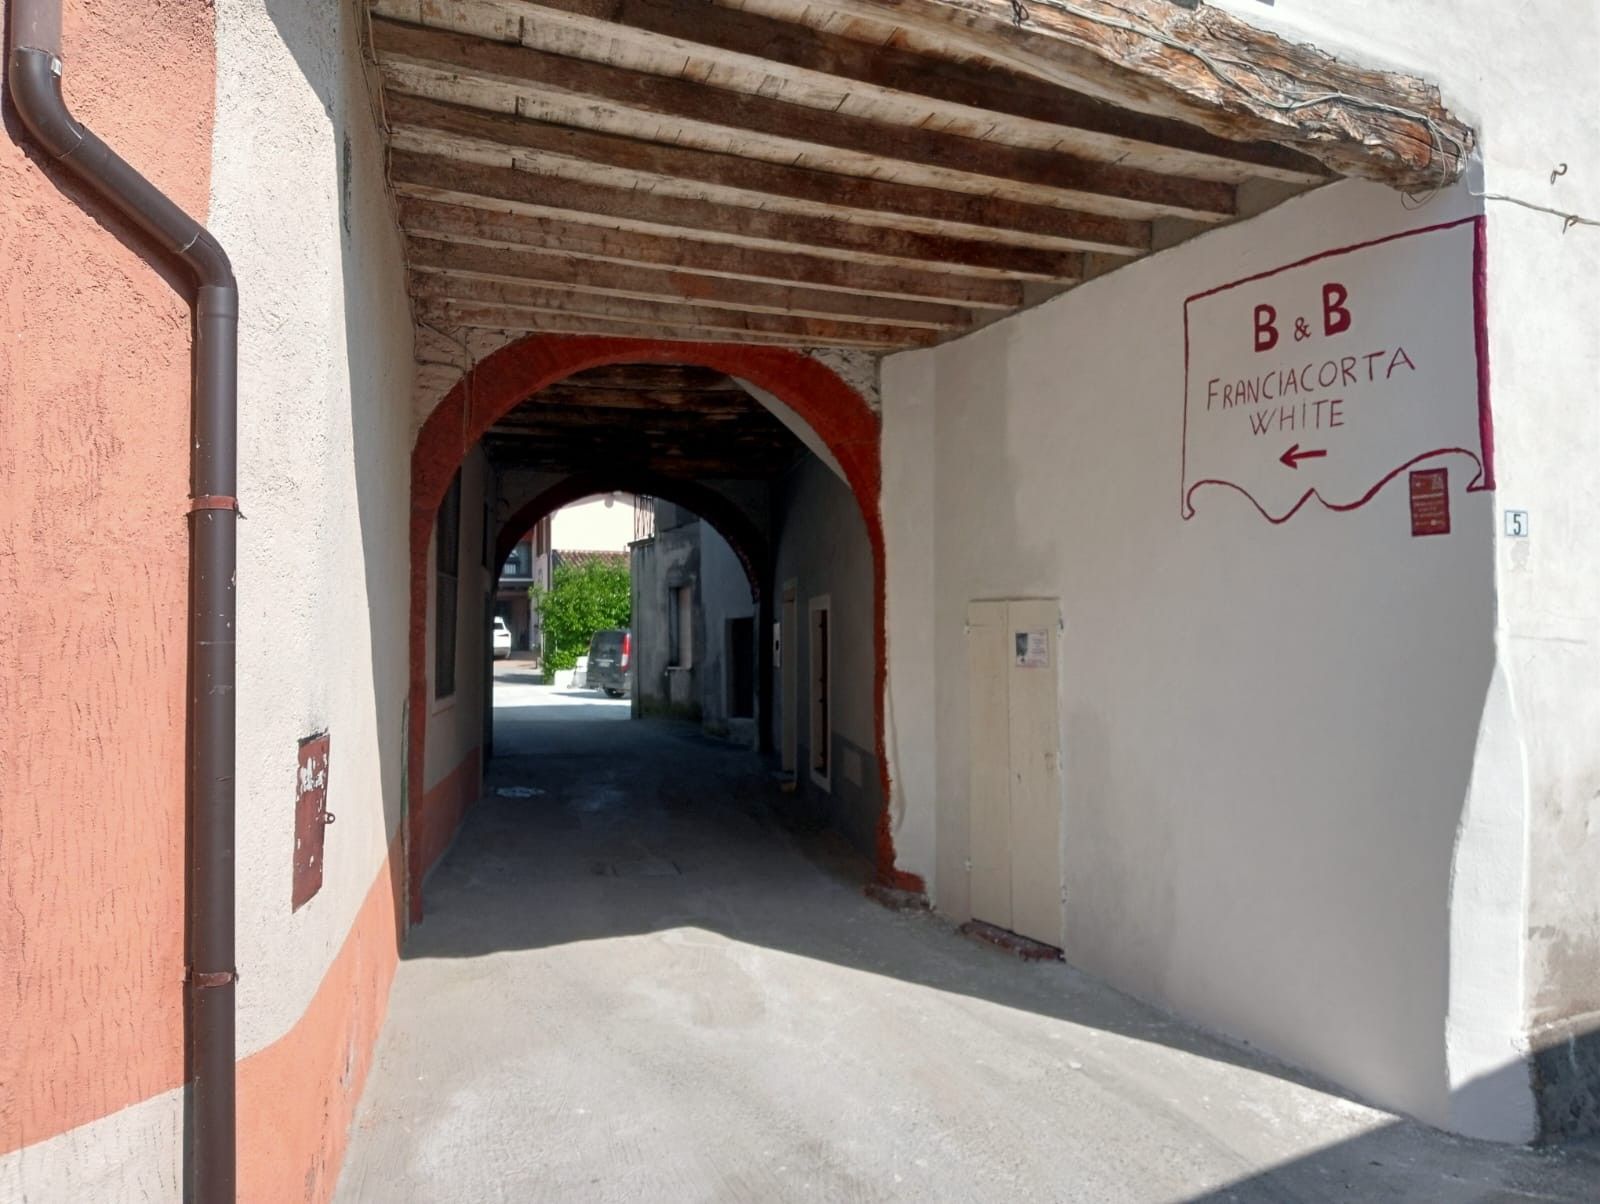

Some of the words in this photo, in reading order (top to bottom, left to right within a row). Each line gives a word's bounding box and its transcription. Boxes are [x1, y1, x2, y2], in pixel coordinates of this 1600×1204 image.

[1254, 304, 1279, 352] B
[1294, 317, 1311, 341] &
[1322, 283, 1351, 336] B
[1207, 347, 1416, 410] FRANCIACORTA
[1250, 399, 1345, 435] WHITE
[1513, 513, 1522, 535] 5
